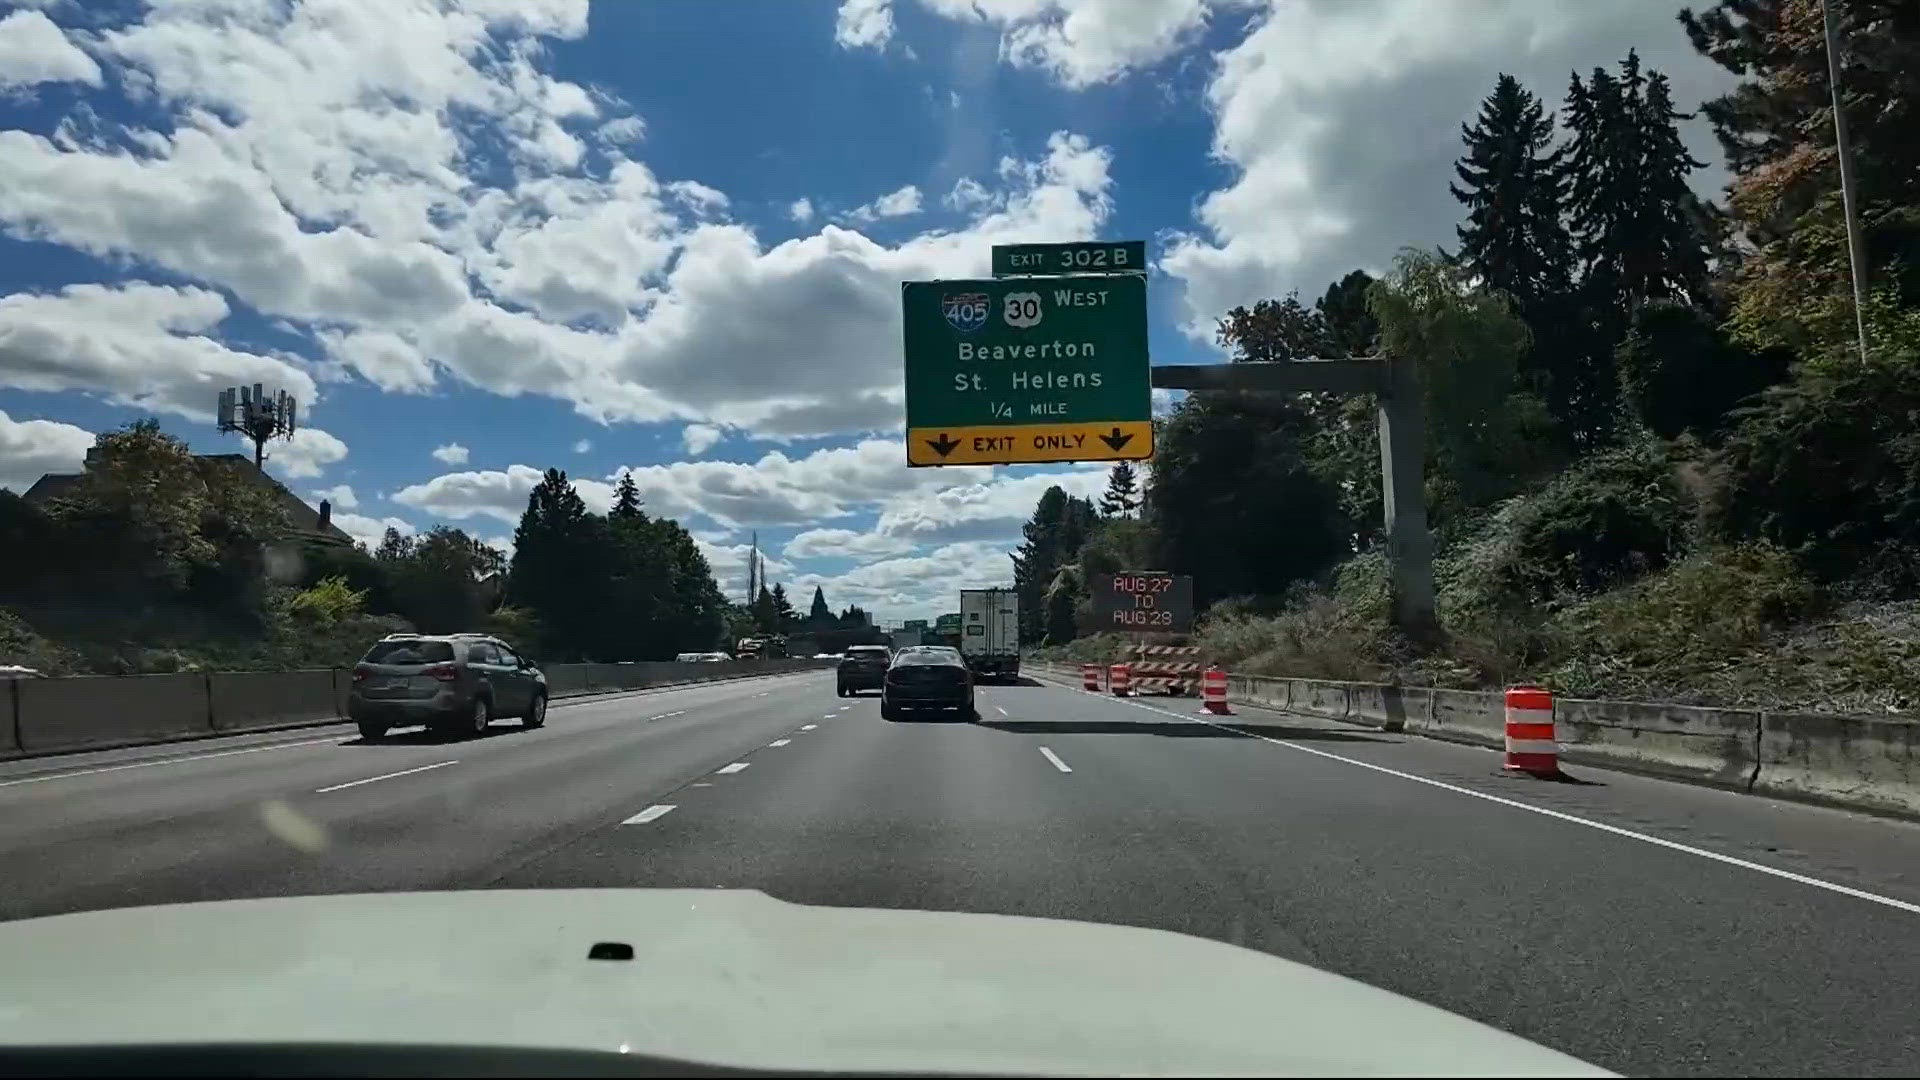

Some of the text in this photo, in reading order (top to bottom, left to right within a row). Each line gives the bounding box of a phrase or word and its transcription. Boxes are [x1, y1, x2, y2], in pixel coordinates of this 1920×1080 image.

[1010, 253, 1043, 266] EXIT
[946, 289, 1109, 322] 405 30 WEST
[959, 341, 1095, 361] Beaverton
[955, 371, 1102, 391] St. Helens
[1030, 403, 1067, 415] MILE
[973, 434, 1086, 451] EXIT ONLY
[1113, 577, 1173, 592] AUG 27
[1135, 594, 1154, 609] TO
[1113, 610, 1146, 624] AUG
